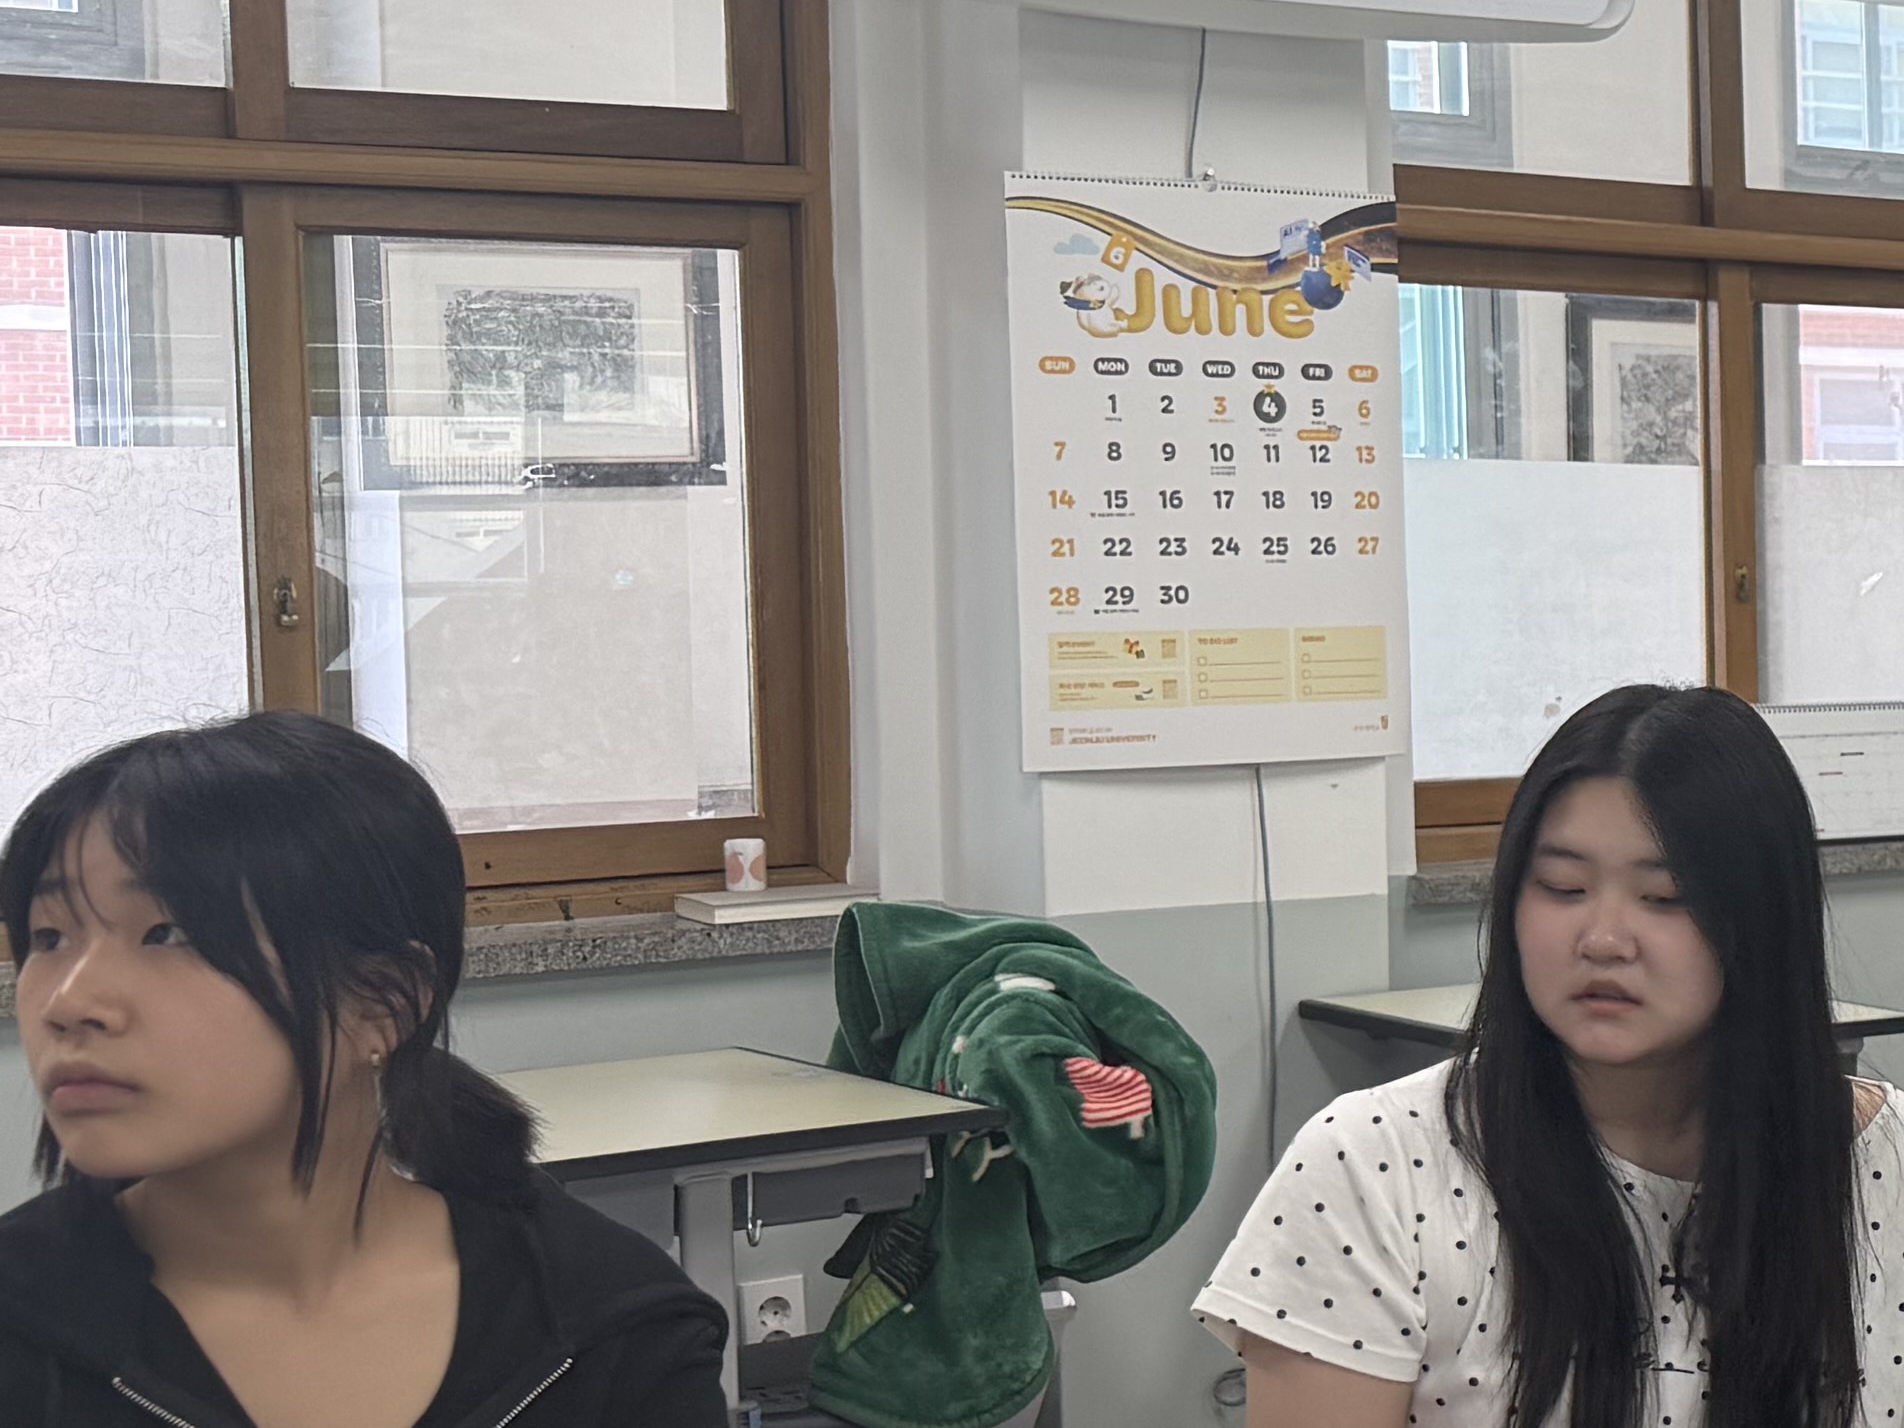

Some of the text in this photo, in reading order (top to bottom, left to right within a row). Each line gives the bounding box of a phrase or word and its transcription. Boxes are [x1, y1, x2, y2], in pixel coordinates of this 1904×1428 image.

[1110, 246, 1125, 265] 6
[1114, 267, 1315, 339] June
[1044, 360, 1070, 371] SUN
[1097, 360, 1126, 373] MON
[1155, 362, 1177, 374] TUE
[1206, 363, 1231, 375] WED
[1257, 366, 1279, 377] THU
[1308, 368, 1326, 378] FRI
[1108, 394, 1370, 419] 1 2 3 4 5 6
[1054, 441, 1375, 464] 7 8 9 10 11 12 13
[1048, 490, 1379, 509] 14 15 16 17 18 19 20
[1051, 537, 1379, 557] 21 22 23 24 25 26 27
[1049, 585, 1189, 606] 28 29 30
